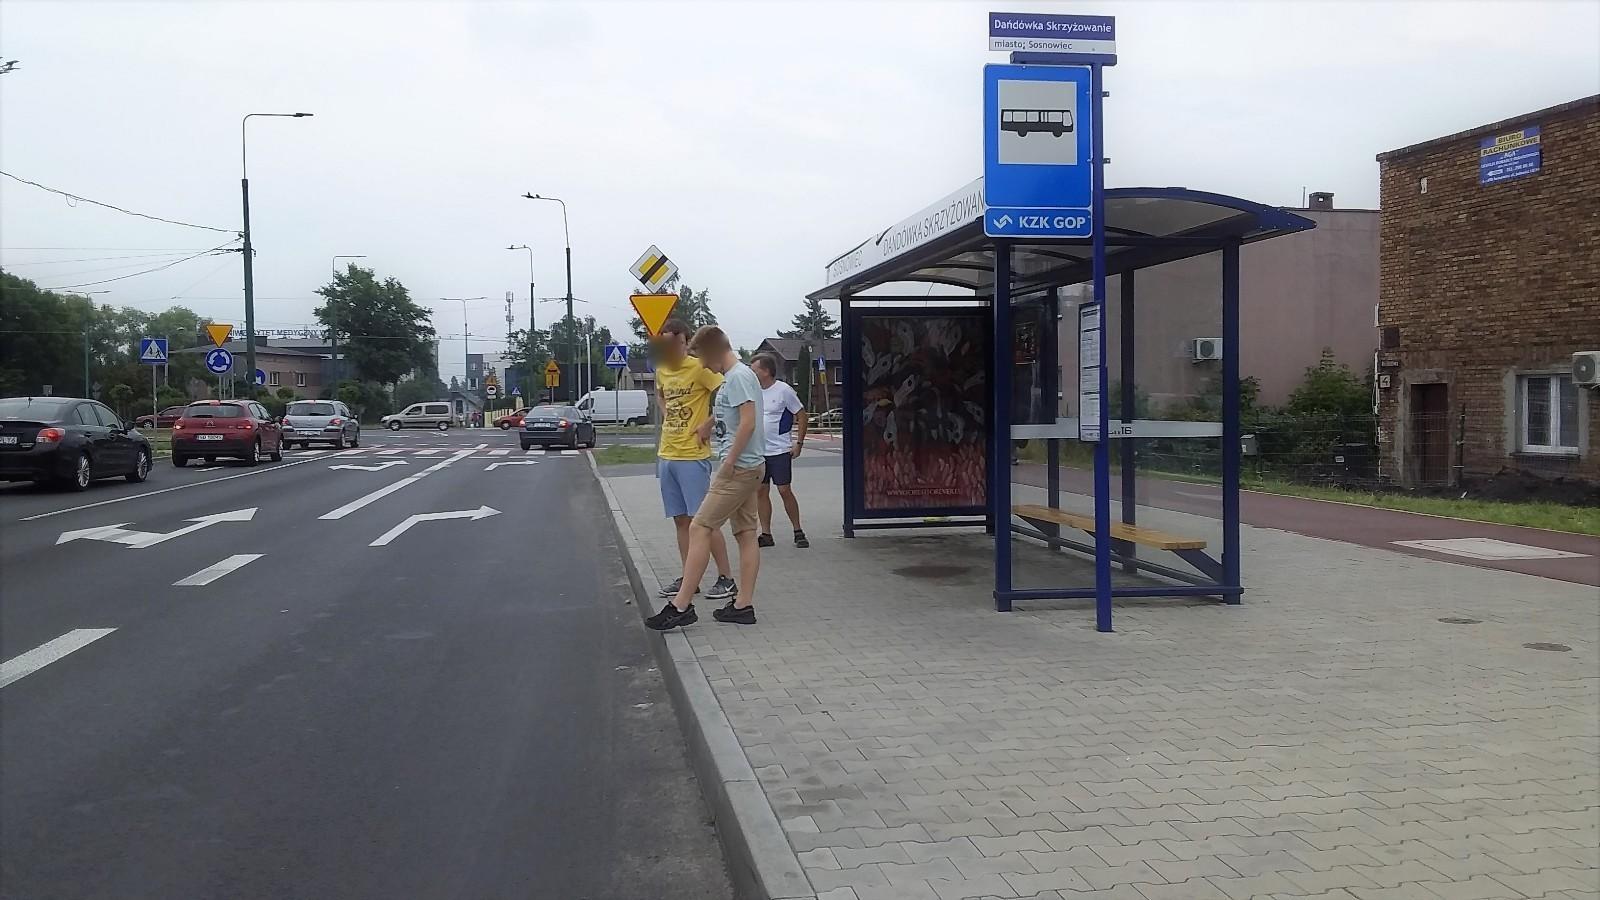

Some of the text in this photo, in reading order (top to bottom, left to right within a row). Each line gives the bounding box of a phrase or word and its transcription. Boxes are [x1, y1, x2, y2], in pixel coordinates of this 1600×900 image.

[994, 19, 1112, 33] Dańdówka Skrzyżowanie
[1028, 41, 1072, 50] Sosnowiec
[1498, 132, 1522, 143] BIURO
[1482, 136, 1538, 155] RACHUNKOWE
[923, 188, 984, 238] SKRZYŻOWAN
[1019, 216, 1086, 229] KZK GOP
